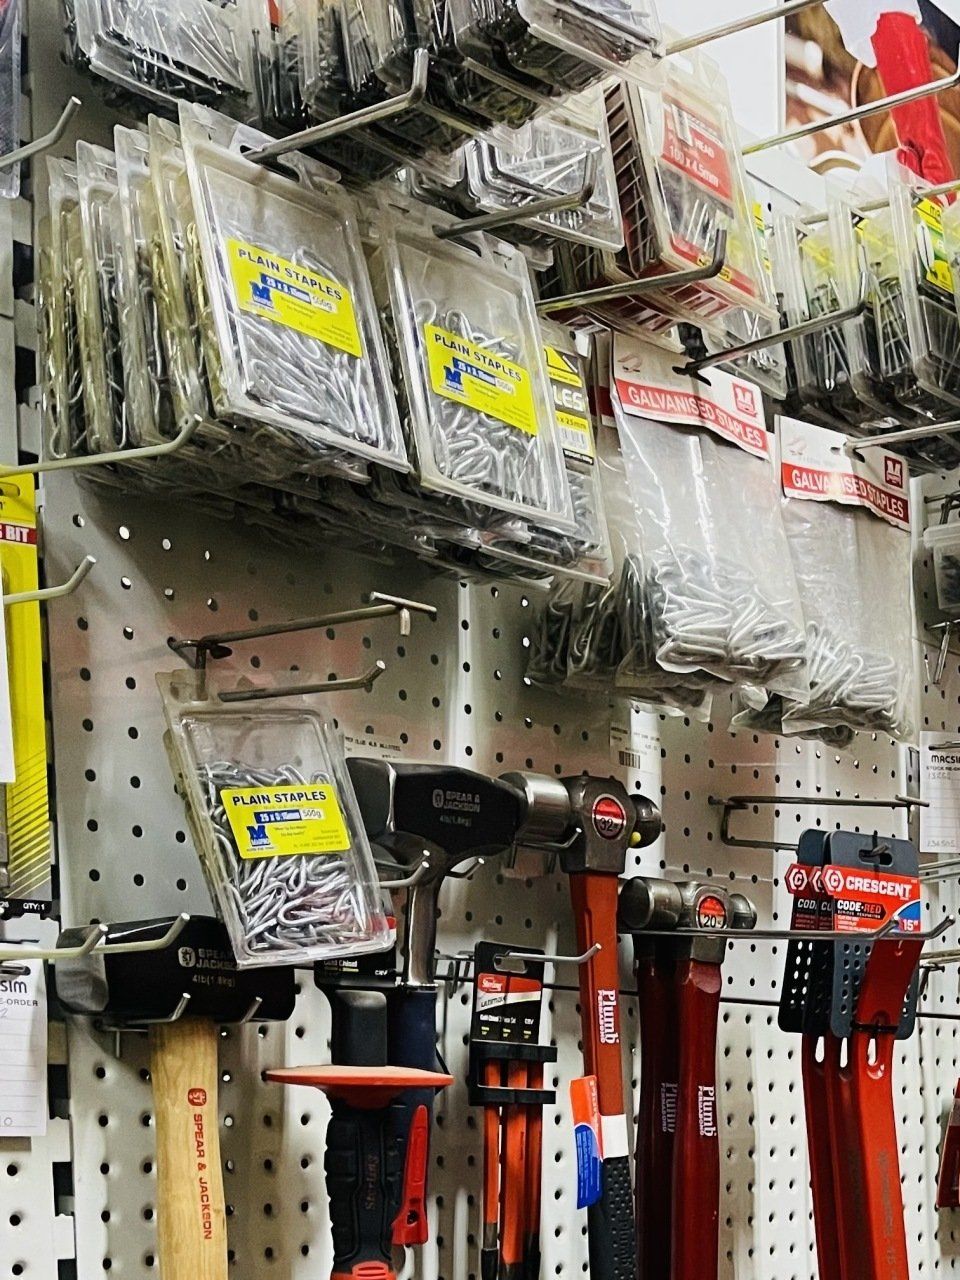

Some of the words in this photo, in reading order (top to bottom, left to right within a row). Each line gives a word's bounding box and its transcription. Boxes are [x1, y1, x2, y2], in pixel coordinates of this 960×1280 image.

[238, 248, 280, 273] PLAIN
[284, 267, 342, 300] STAPLES
[434, 333, 470, 357] PLAIN
[474, 352, 522, 382] STAPLES
[627, 386, 715, 421] GALVANISED
[716, 410, 764, 448] STAPLES
[867, 486, 905, 519] STAPLES
[5, 524, 30, 543] BIT
[232, 793, 271, 806] PLAIN
[274, 791, 327, 803] STAPLES
[443, 800, 481, 814] JACKSON
[599, 817, 614, 832] 32
[845, 875, 912, 899] CRESCENT
[703, 914, 717, 929] 20
[602, 989, 619, 1044] Plumb
[702, 1086, 717, 1137] Plumb
[193, 1113, 205, 1158] SPEAR
[198, 1162, 207, 1172] &
[199, 1176, 212, 1240] JACKSON
